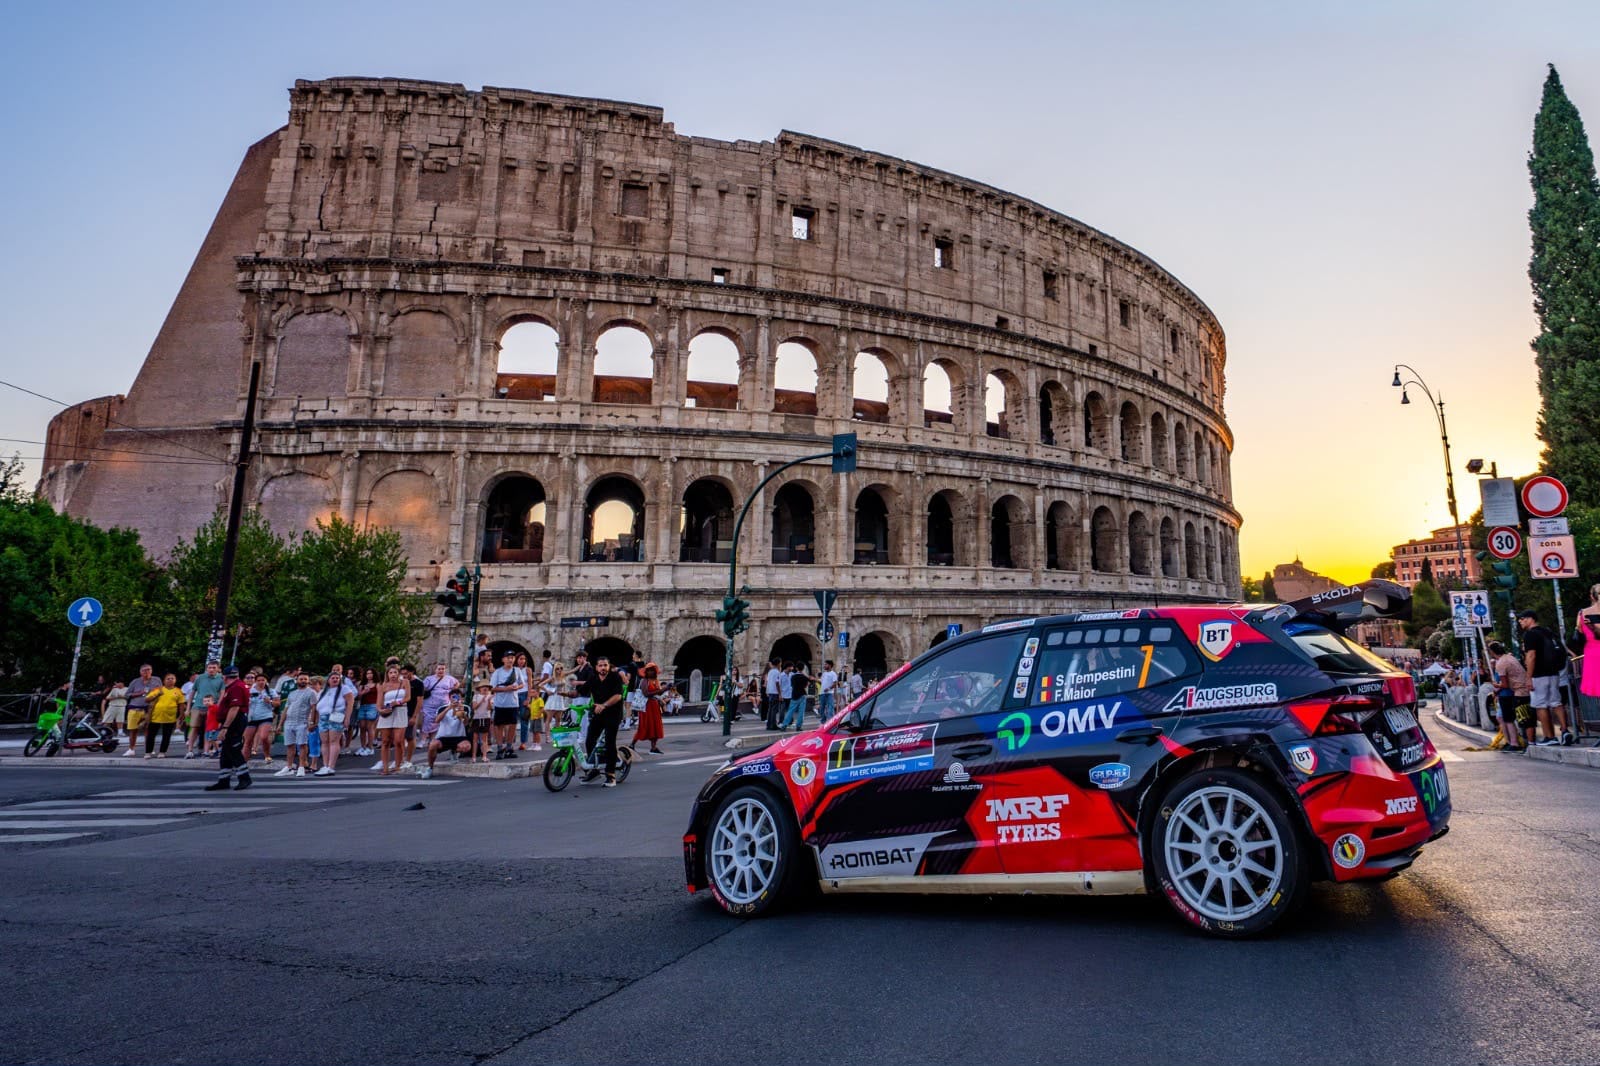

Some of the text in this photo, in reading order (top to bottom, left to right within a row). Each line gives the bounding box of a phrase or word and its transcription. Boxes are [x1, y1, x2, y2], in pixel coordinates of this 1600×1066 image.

[1495, 535, 1514, 550] 30
[1206, 629, 1229, 642] BT
[1055, 665, 1136, 686] S. Tempestini
[1138, 645, 1154, 689] 7
[1055, 687, 1097, 702] F.Maior
[1195, 684, 1275, 702] AUGSBURG
[1040, 701, 1122, 737] OMV
[836, 740, 847, 768] 7
[1296, 750, 1311, 762] BT
[742, 763, 771, 775] sparco
[849, 764, 906, 777] FIA ERC Championship
[986, 794, 1069, 822] MRF
[1385, 796, 1418, 815] MRF
[997, 823, 1061, 843] TYRES
[831, 847, 915, 870] ROMBAT
